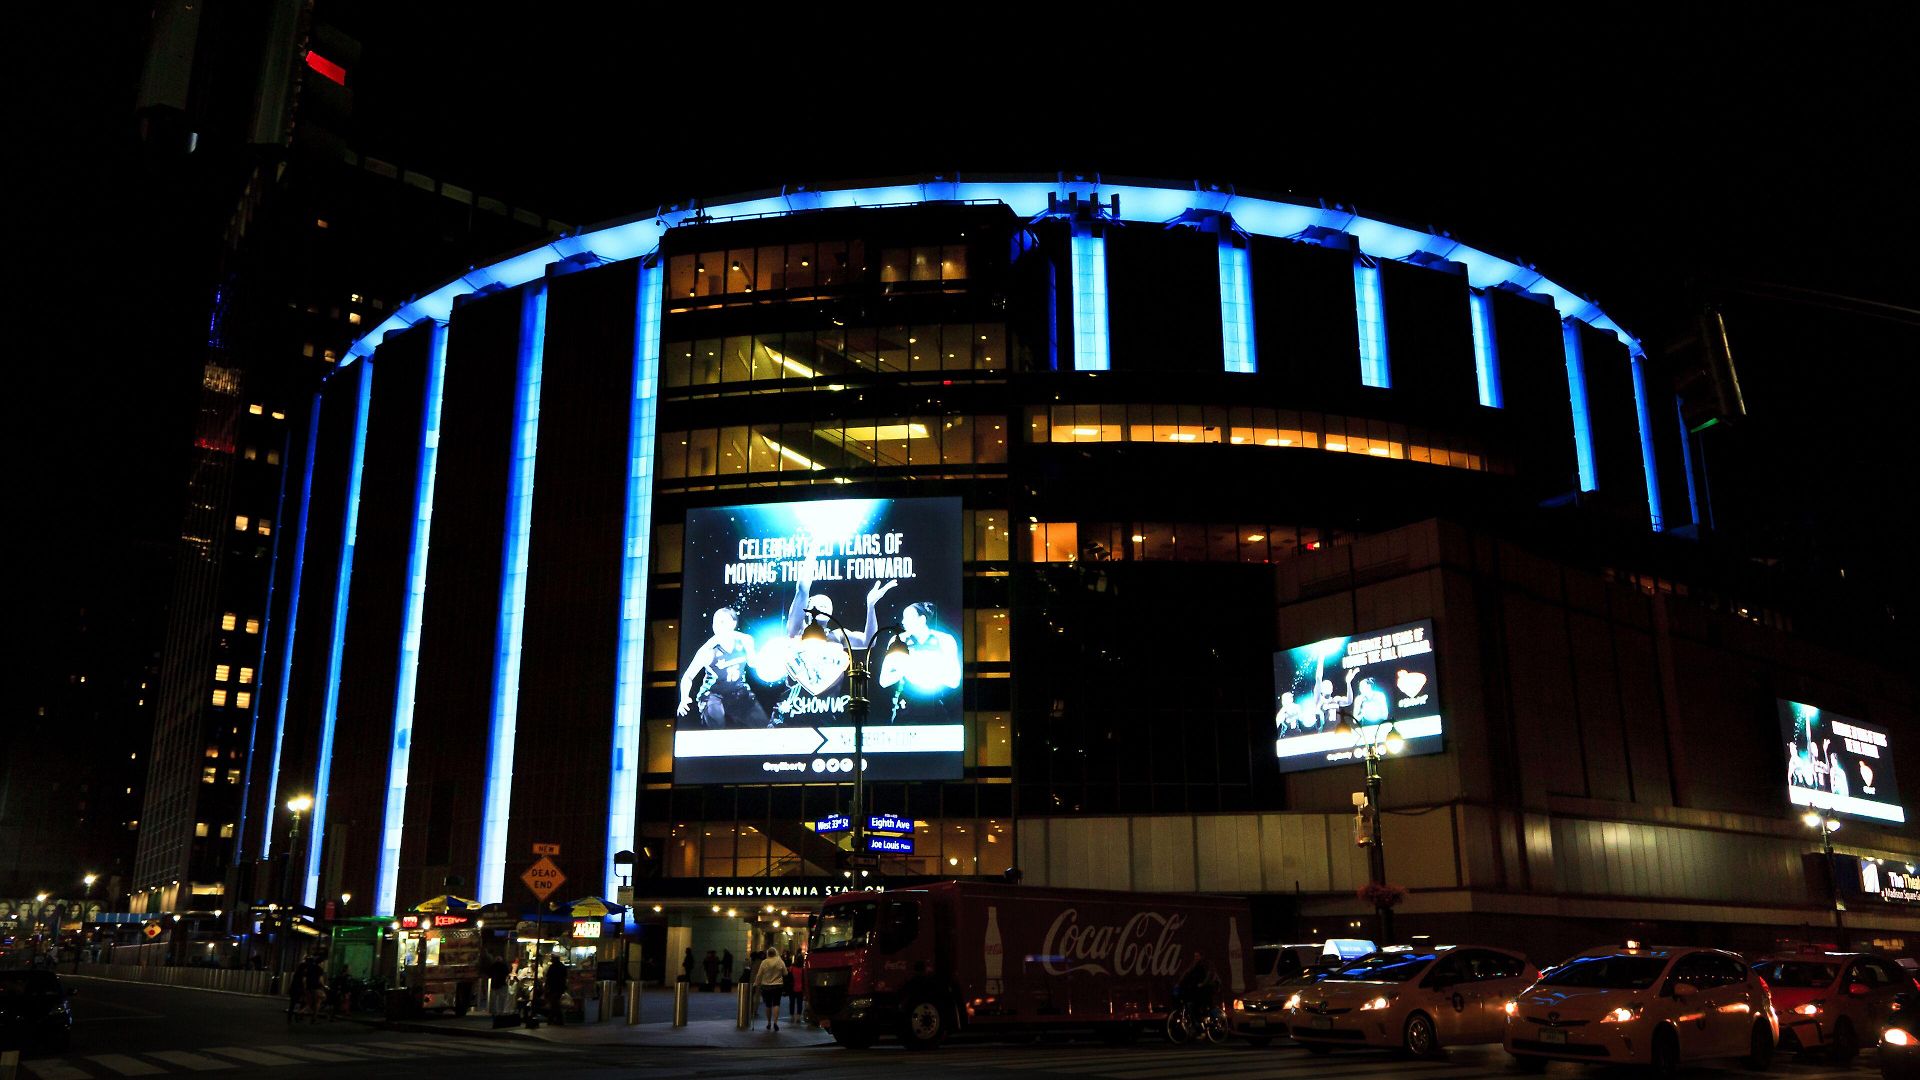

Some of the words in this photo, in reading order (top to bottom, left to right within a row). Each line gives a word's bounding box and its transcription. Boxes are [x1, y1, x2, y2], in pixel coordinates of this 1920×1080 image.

[839, 533, 881, 556] YEARS
[884, 532, 904, 555] OF
[724, 561, 778, 585] MOVING
[846, 556, 917, 580] FORWARD.
[817, 821, 831, 831] West
[842, 818, 849, 827] St
[871, 817, 894, 829] Eighth
[895, 819, 910, 829] Ave
[871, 839, 882, 849] Joe
[883, 839, 900, 850] Louis
[531, 869, 557, 878] DEAD
[534, 880, 552, 889] END
[707, 885, 819, 897] PENNSYLVANIA
[825, 885, 885, 897] STAON
[1042, 908, 1187, 977] Coca-Cola
